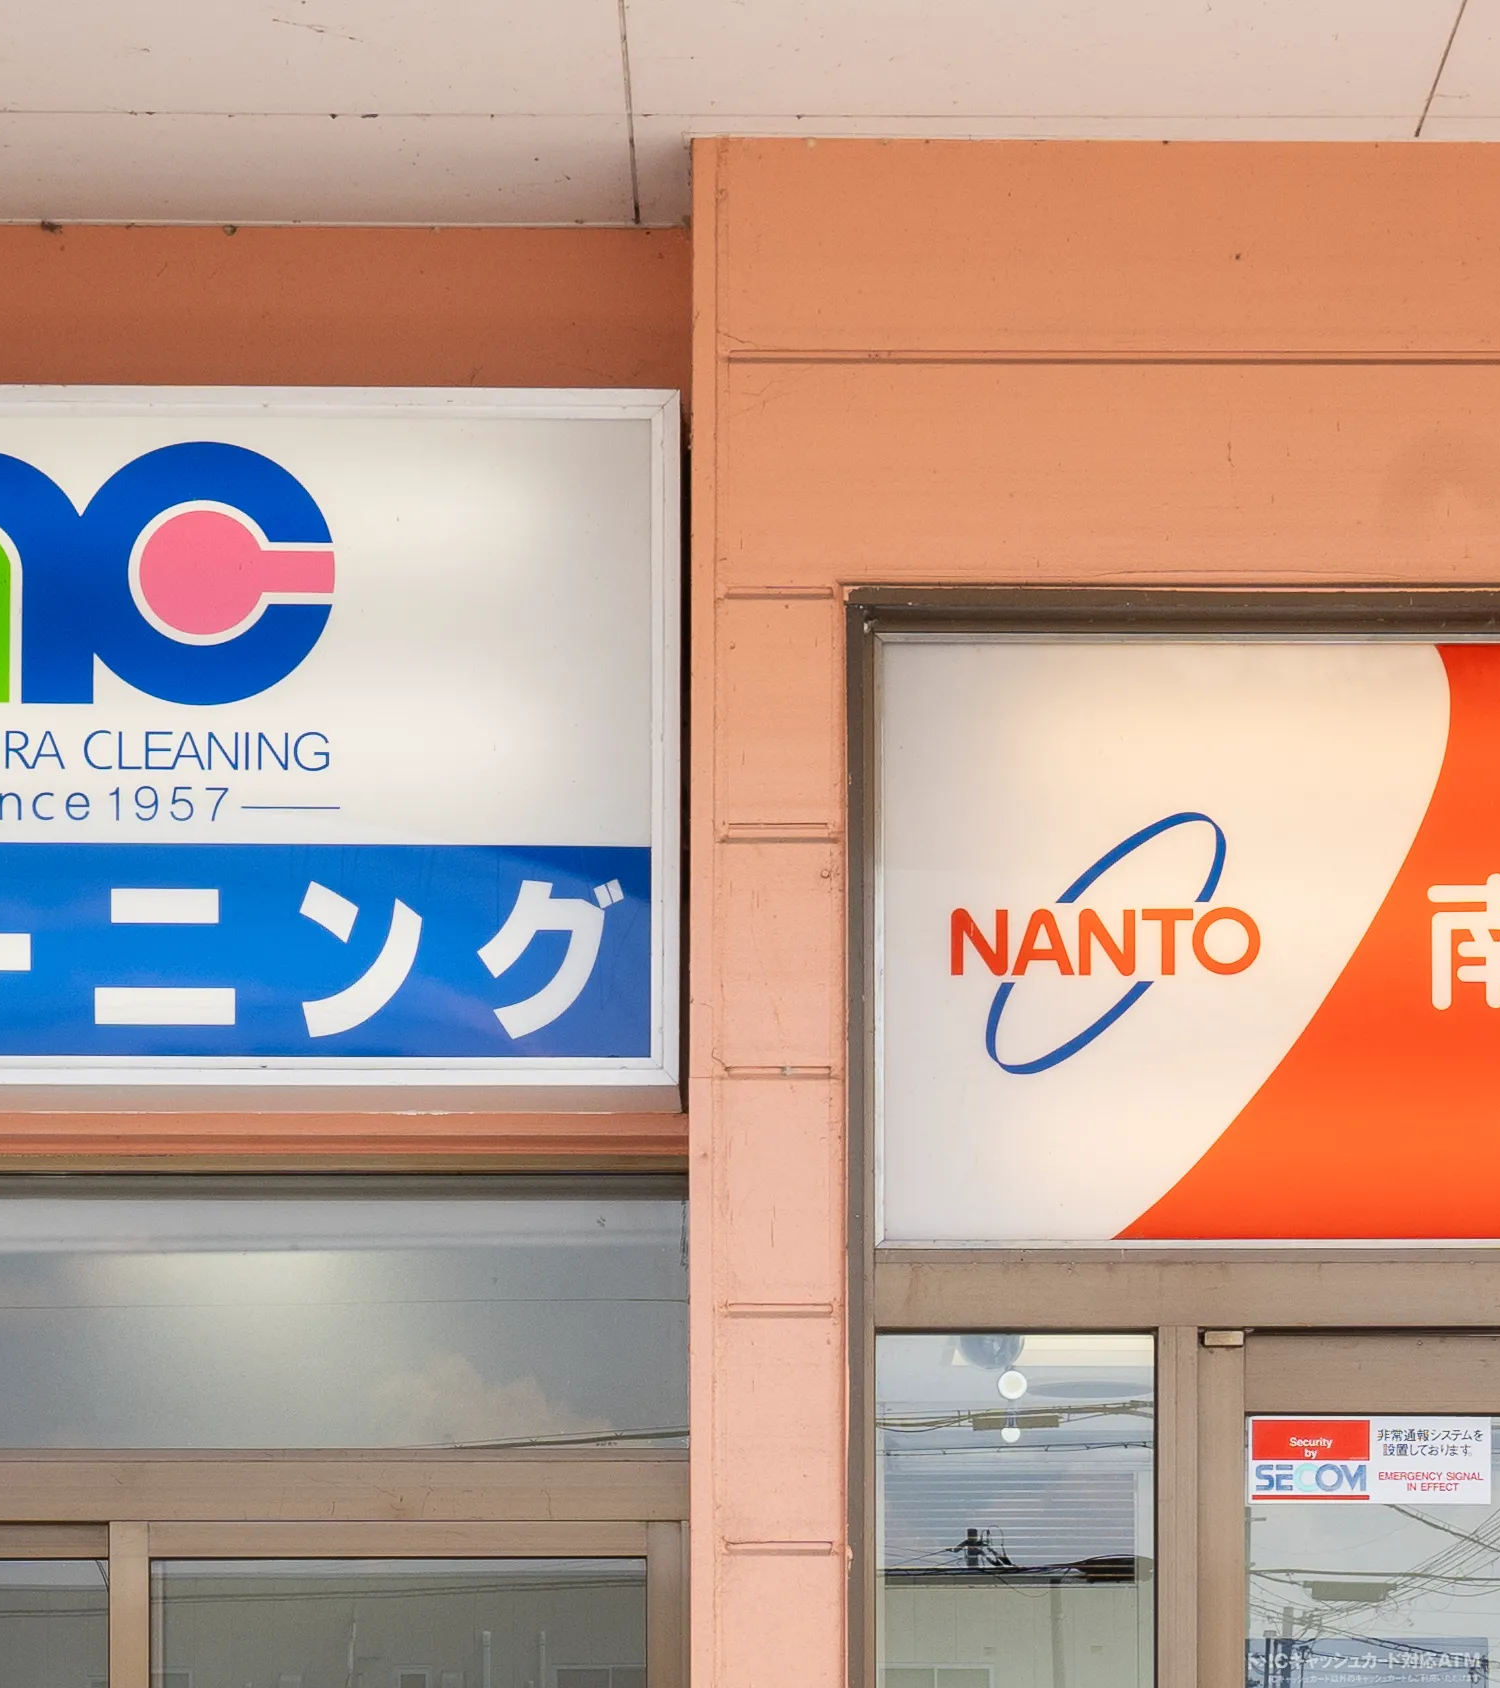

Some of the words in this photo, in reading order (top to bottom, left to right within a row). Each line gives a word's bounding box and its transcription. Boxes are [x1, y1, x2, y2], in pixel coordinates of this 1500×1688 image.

[83, 729, 332, 773] CLEANING
[108, 785, 231, 824] 1957
[949, 906, 1262, 978] NANTO
[1377, 1429, 1484, 1442] 非常通報システムを
[1289, 1437, 1333, 1449] Security
[1304, 1449, 1317, 1459] by
[1383, 1443, 1473, 1457] 設置しております。
[1255, 1463, 1367, 1492] SECOM
[1378, 1471, 1443, 1481] EMERGENCY
[1446, 1471, 1484, 1481] SIGNAL
[1407, 1483, 1416, 1491] IN
[1421, 1483, 1459, 1491] EFFECT
